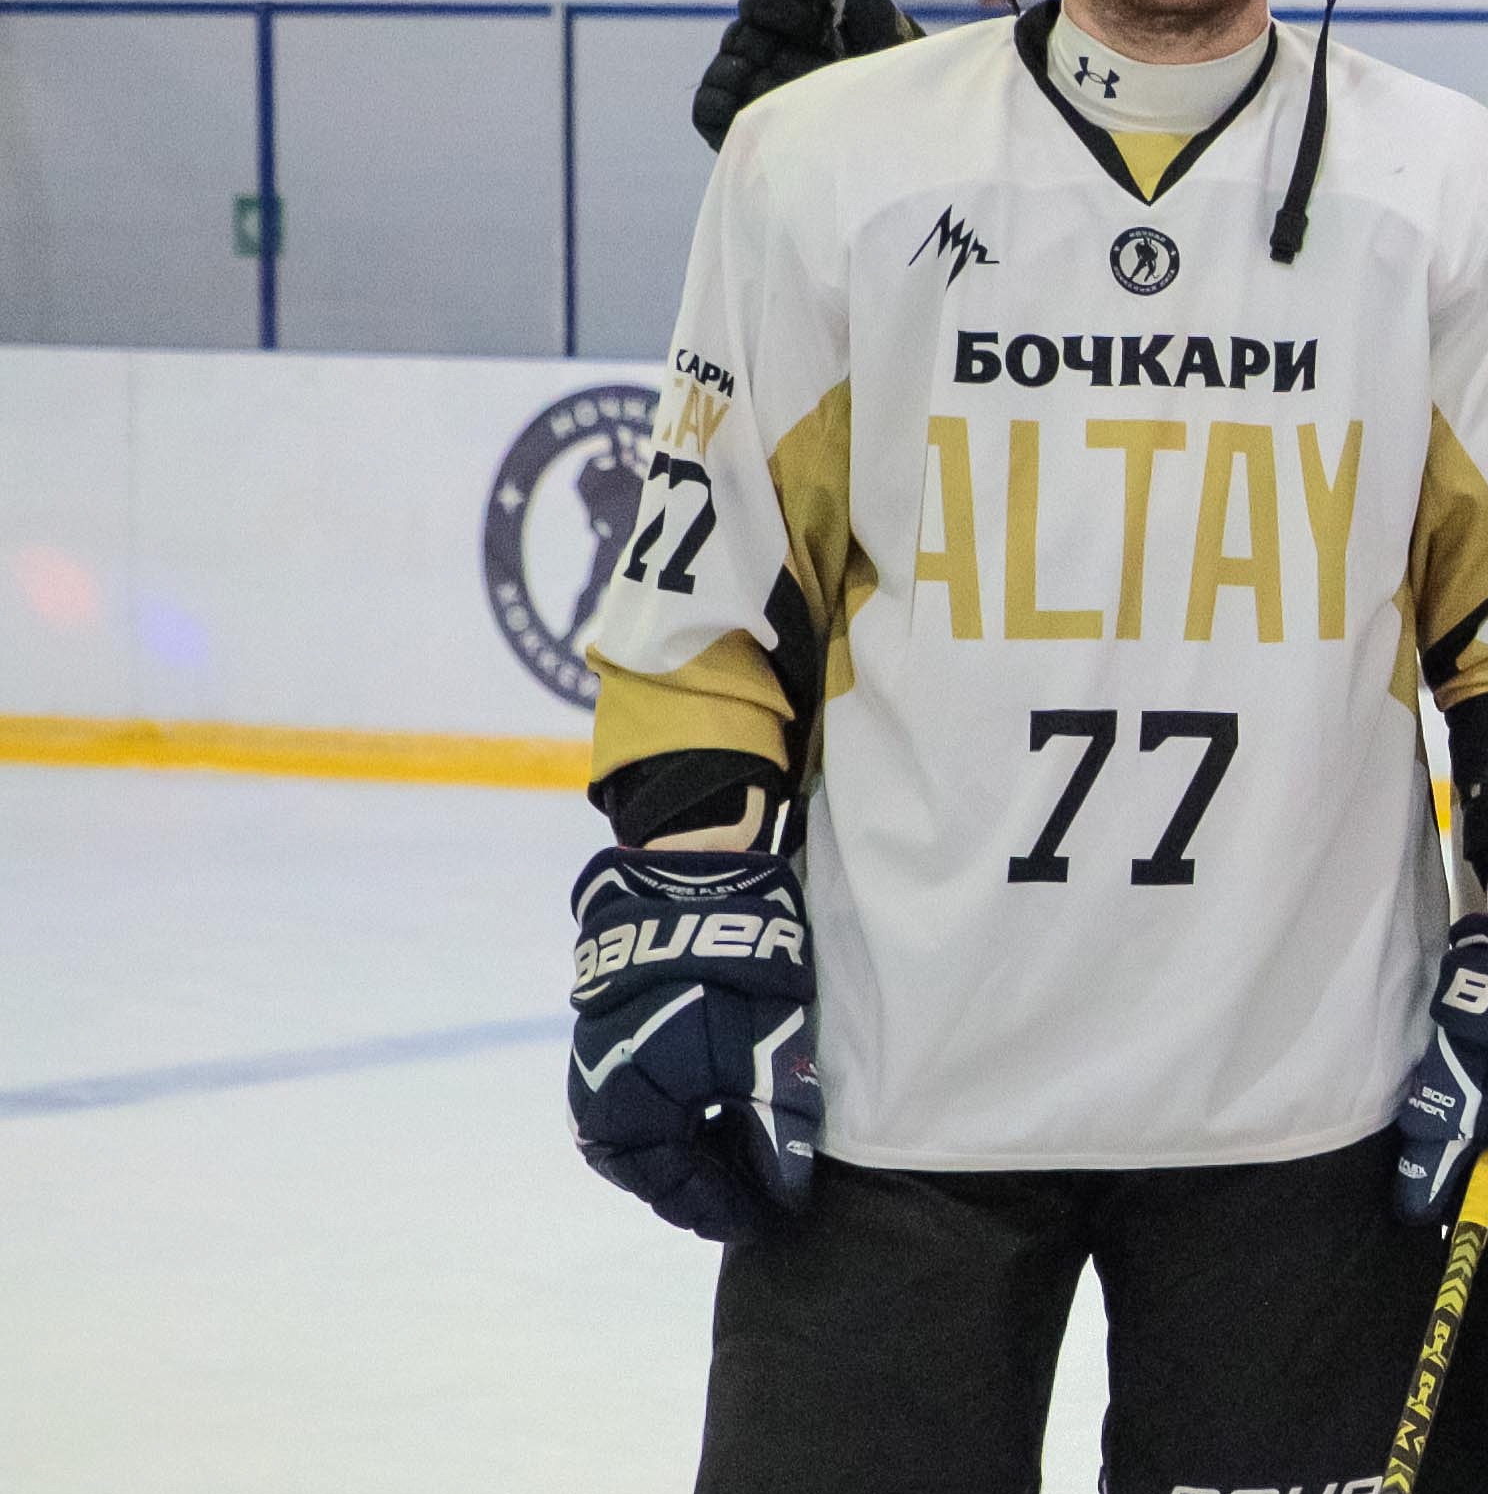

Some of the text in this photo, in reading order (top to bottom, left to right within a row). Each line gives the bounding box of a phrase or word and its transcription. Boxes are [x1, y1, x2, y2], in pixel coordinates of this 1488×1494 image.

[953, 330, 1319, 393] БОЧКАРИ
[910, 414, 1363, 644] ALTAY
[1007, 709, 1239, 886] 77
[573, 913, 803, 987] BAUER
